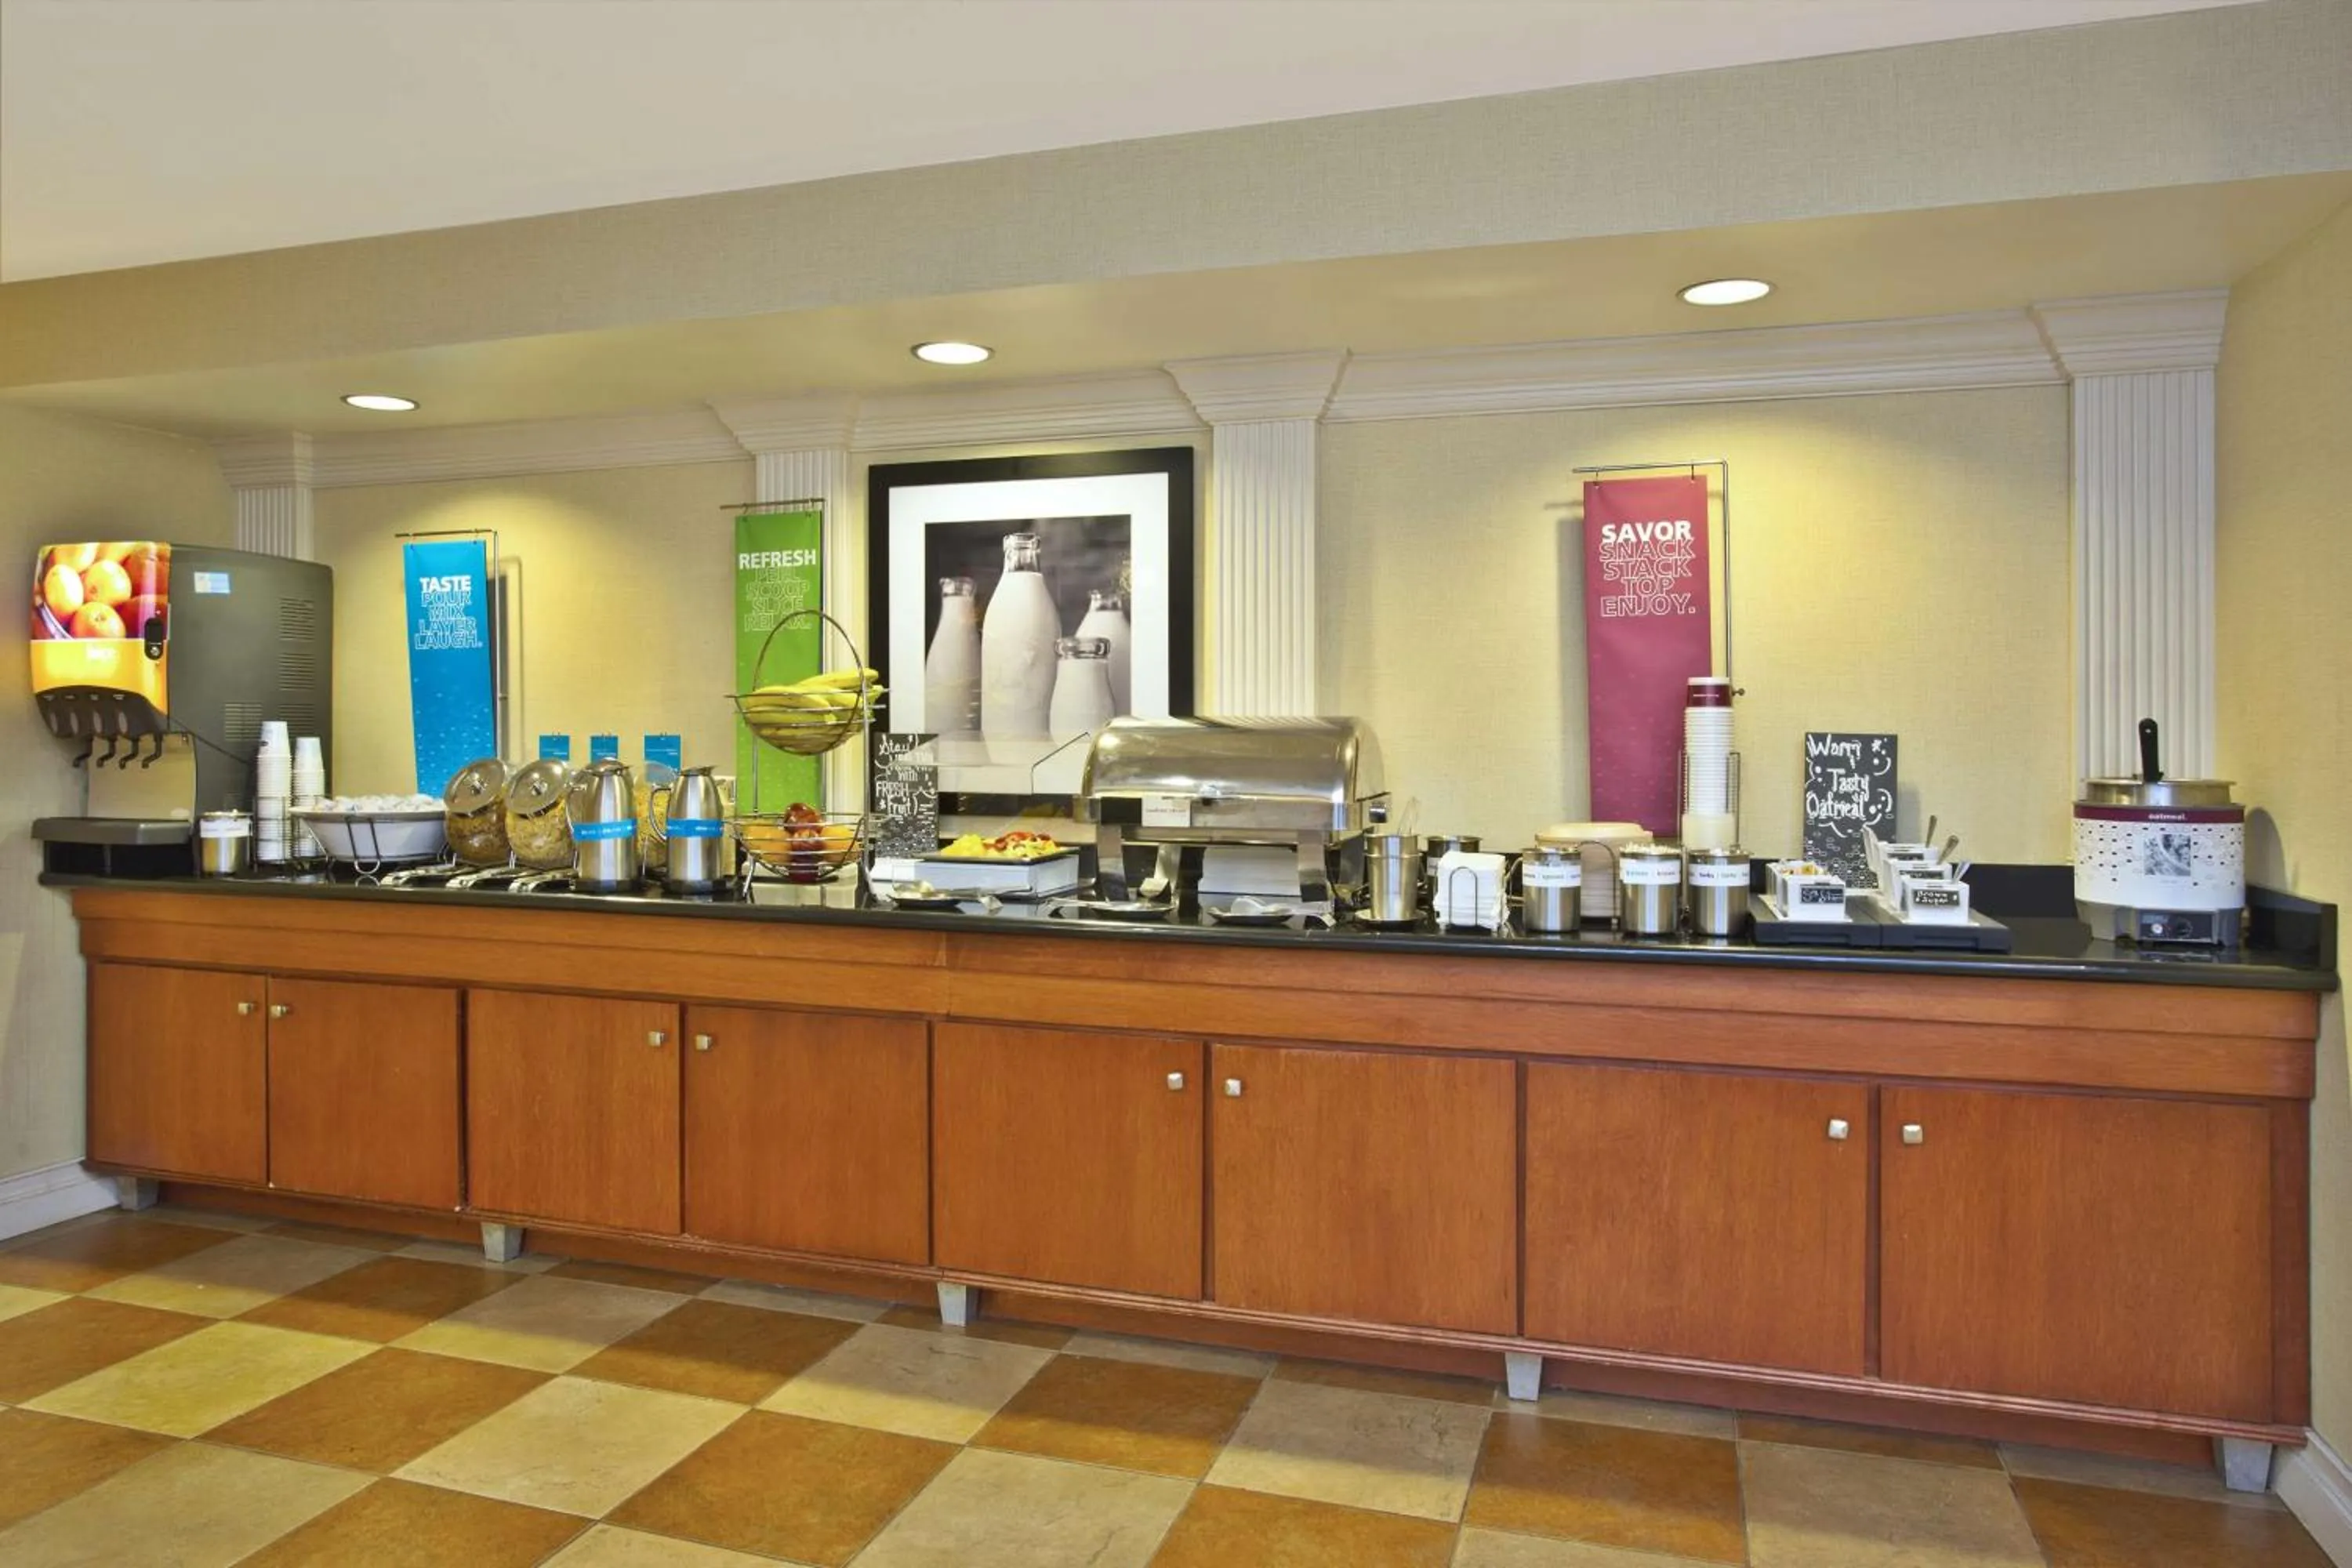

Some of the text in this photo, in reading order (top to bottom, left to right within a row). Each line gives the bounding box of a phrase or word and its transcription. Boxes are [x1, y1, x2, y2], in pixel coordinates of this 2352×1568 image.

[1601, 520, 1692, 546] SAVOR
[739, 548, 816, 570] REFRESH
[1599, 536, 1697, 562] SNACK
[1603, 555, 1693, 581] STACK
[419, 575, 472, 593] TASTE
[746, 580, 810, 601] SCOOP
[1621, 576, 1675, 597] TOP
[421, 590, 472, 608] POUR
[1600, 592, 1697, 618] ENJOY.
[429, 603, 465, 622] MIX
[418, 615, 477, 636] LAYER
[1806, 733, 1862, 761] Warm
[876, 780, 909, 798] FRESH
[1826, 768, 1870, 802] Tasty
[1806, 789, 1867, 821] Oatmeal
